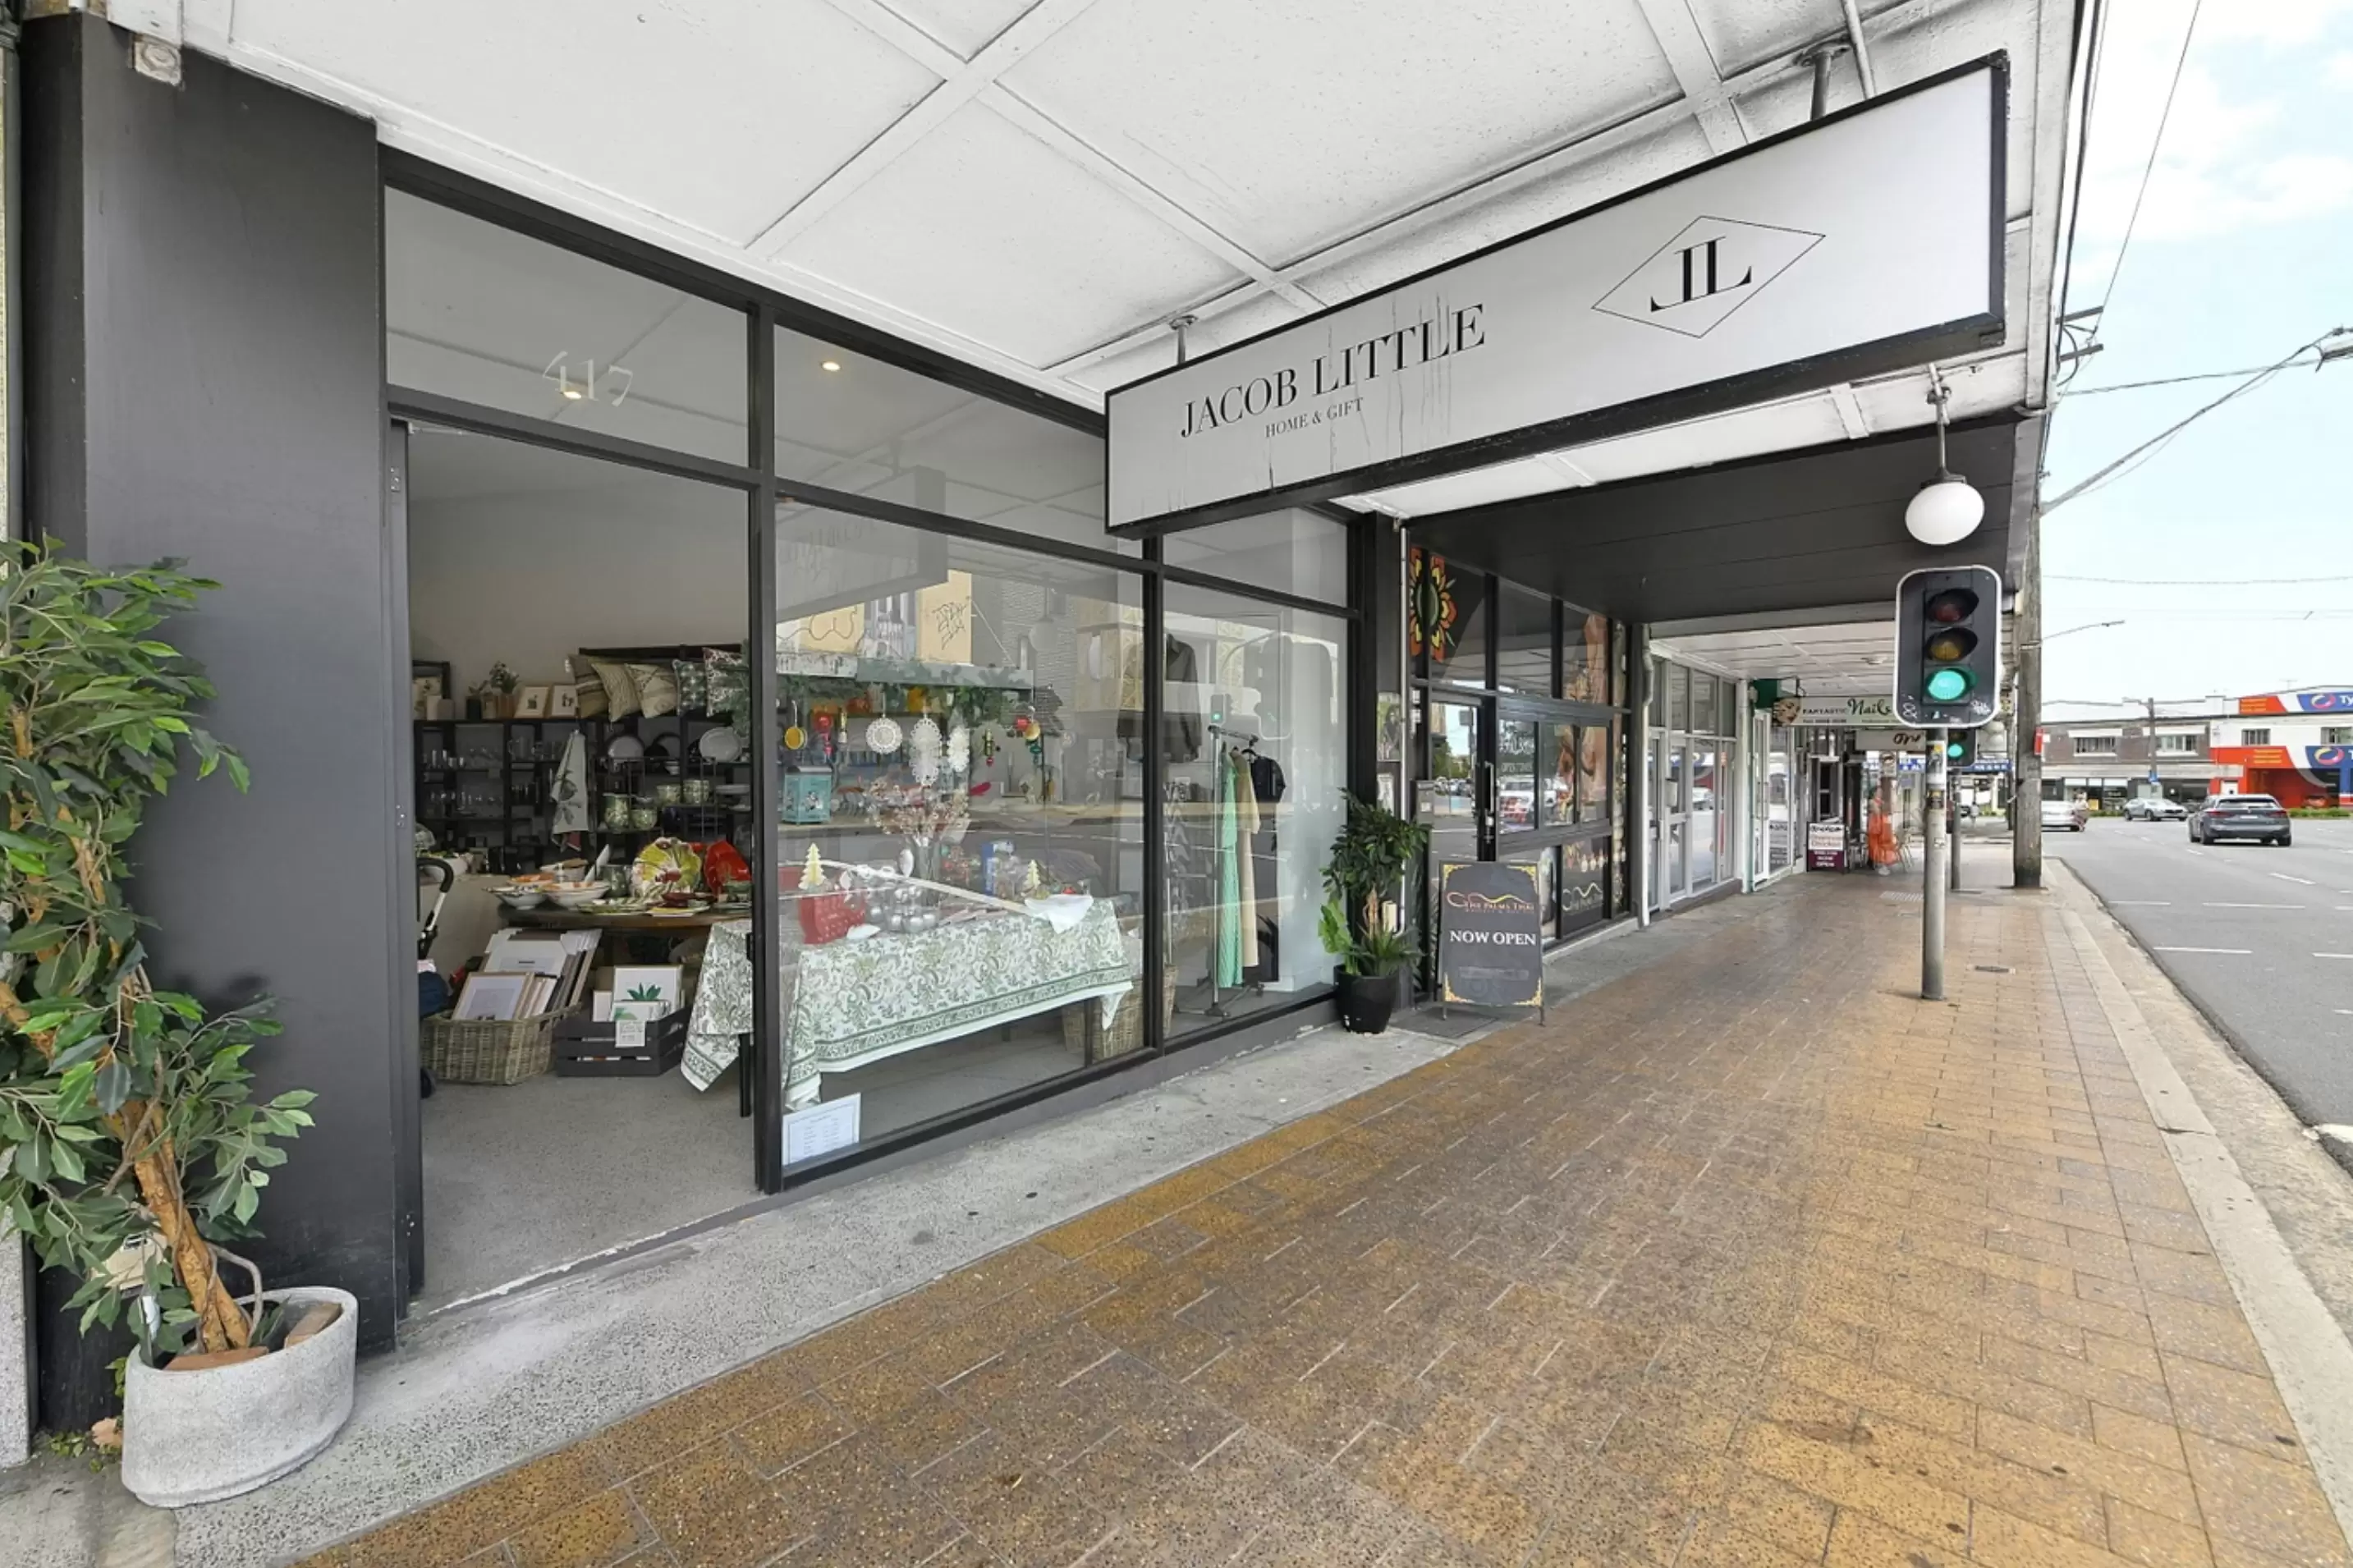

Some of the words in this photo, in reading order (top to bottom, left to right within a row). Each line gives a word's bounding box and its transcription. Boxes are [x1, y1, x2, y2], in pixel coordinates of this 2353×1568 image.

[542, 350, 634, 408] 417
[1181, 368, 1298, 438] JACOB
[1311, 304, 1485, 397] LITTLE
[1264, 413, 1309, 438] HOME
[1311, 410, 1323, 424] &
[1326, 397, 1365, 420] GIFT
[1450, 930, 1490, 943] NOW
[1492, 932, 1537, 946] OPEN
